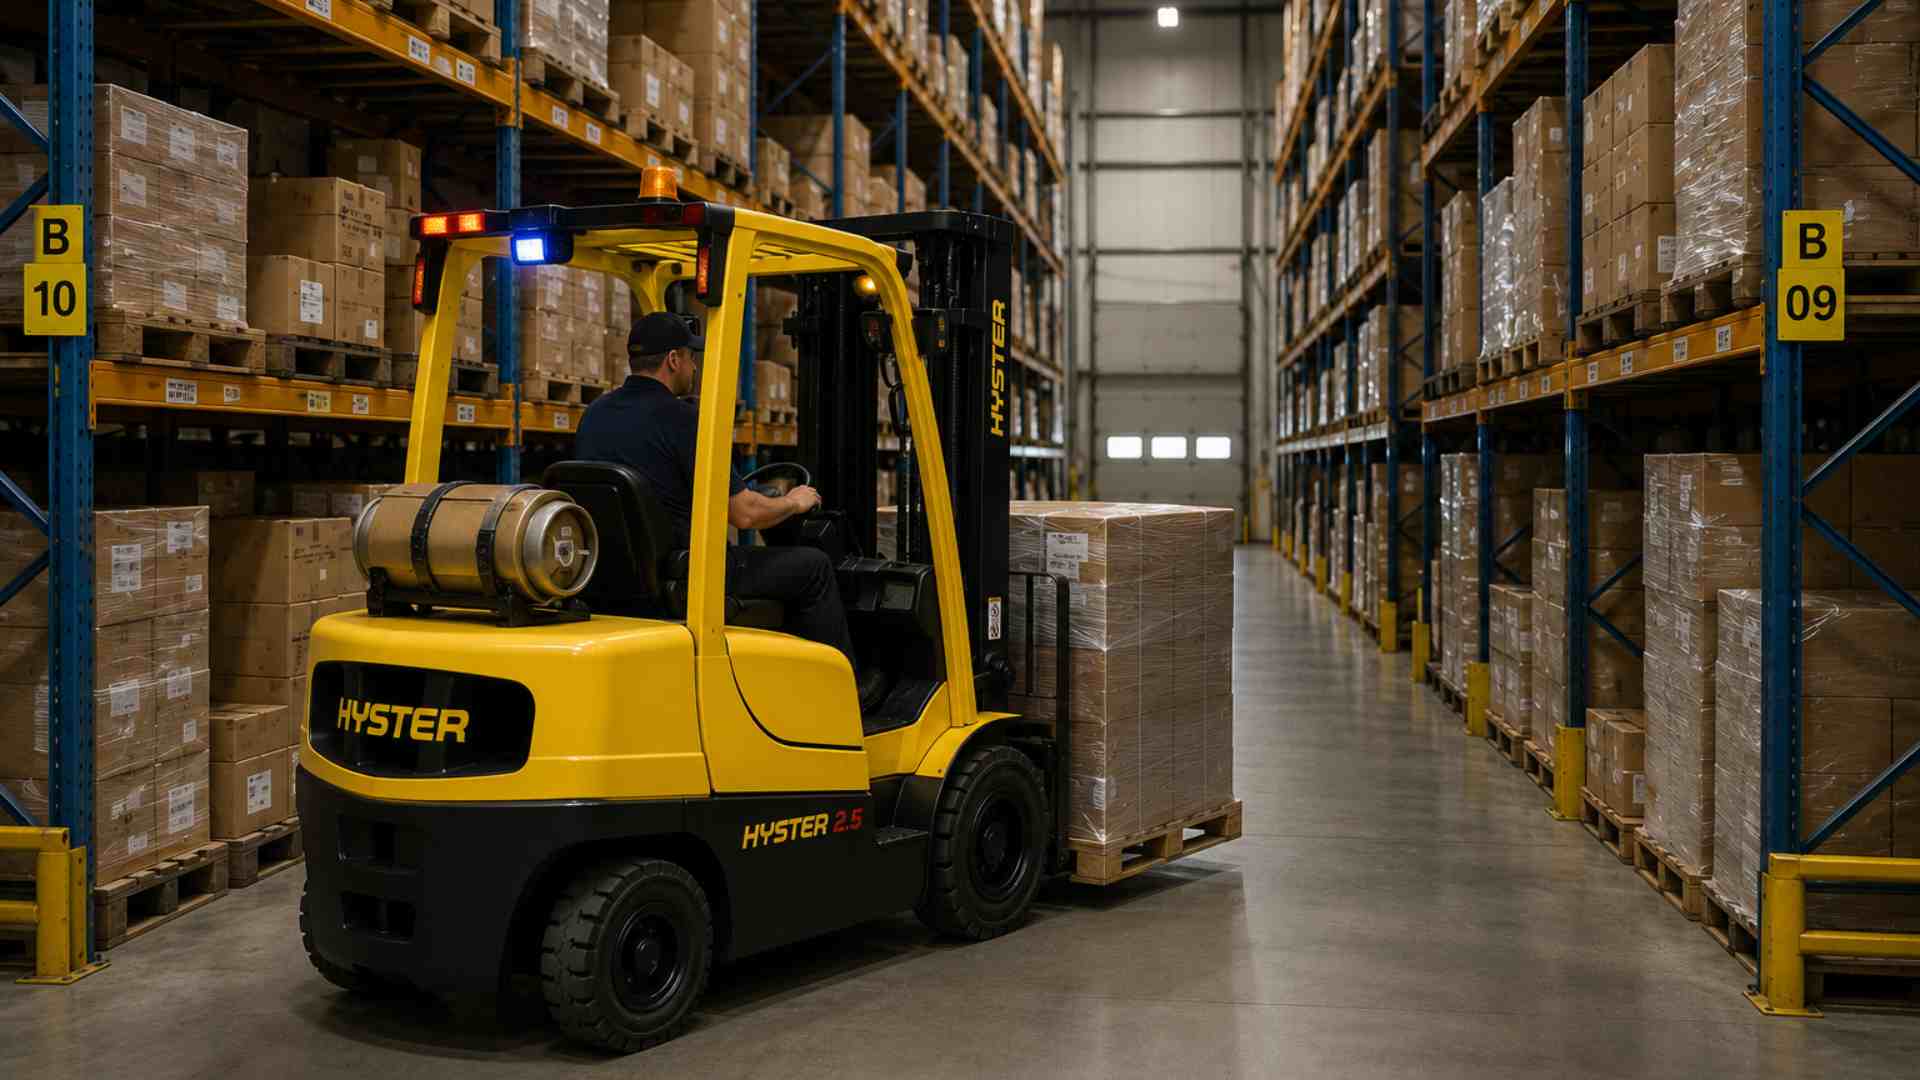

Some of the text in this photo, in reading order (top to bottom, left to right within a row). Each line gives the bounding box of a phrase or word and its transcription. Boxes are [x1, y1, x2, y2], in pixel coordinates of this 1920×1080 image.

[42, 217, 70, 256] B
[1799, 222, 1828, 261] B
[33, 280, 77, 317] 10
[1786, 284, 1837, 322] 09
[990, 299, 1007, 437] HYSTER
[337, 697, 470, 743] HYSTER
[741, 807, 864, 849] HYSTER 2.5
